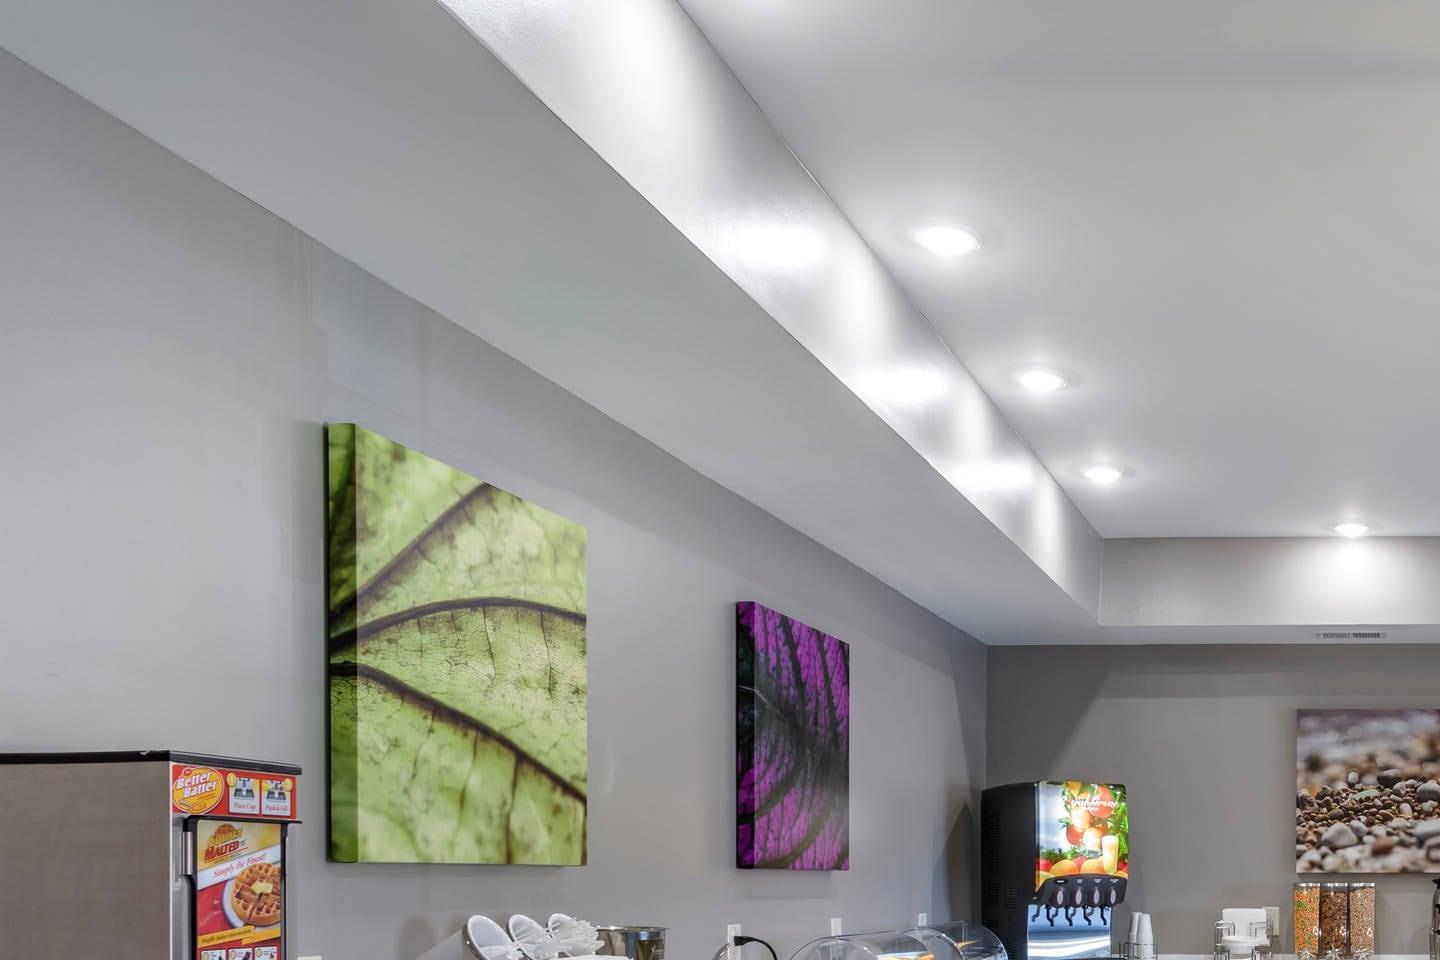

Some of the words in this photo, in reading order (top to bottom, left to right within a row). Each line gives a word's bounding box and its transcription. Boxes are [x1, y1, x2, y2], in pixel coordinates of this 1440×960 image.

[176, 772, 212, 789] Better
[183, 781, 217, 798] Batter
[205, 841, 240, 862] MALTED
